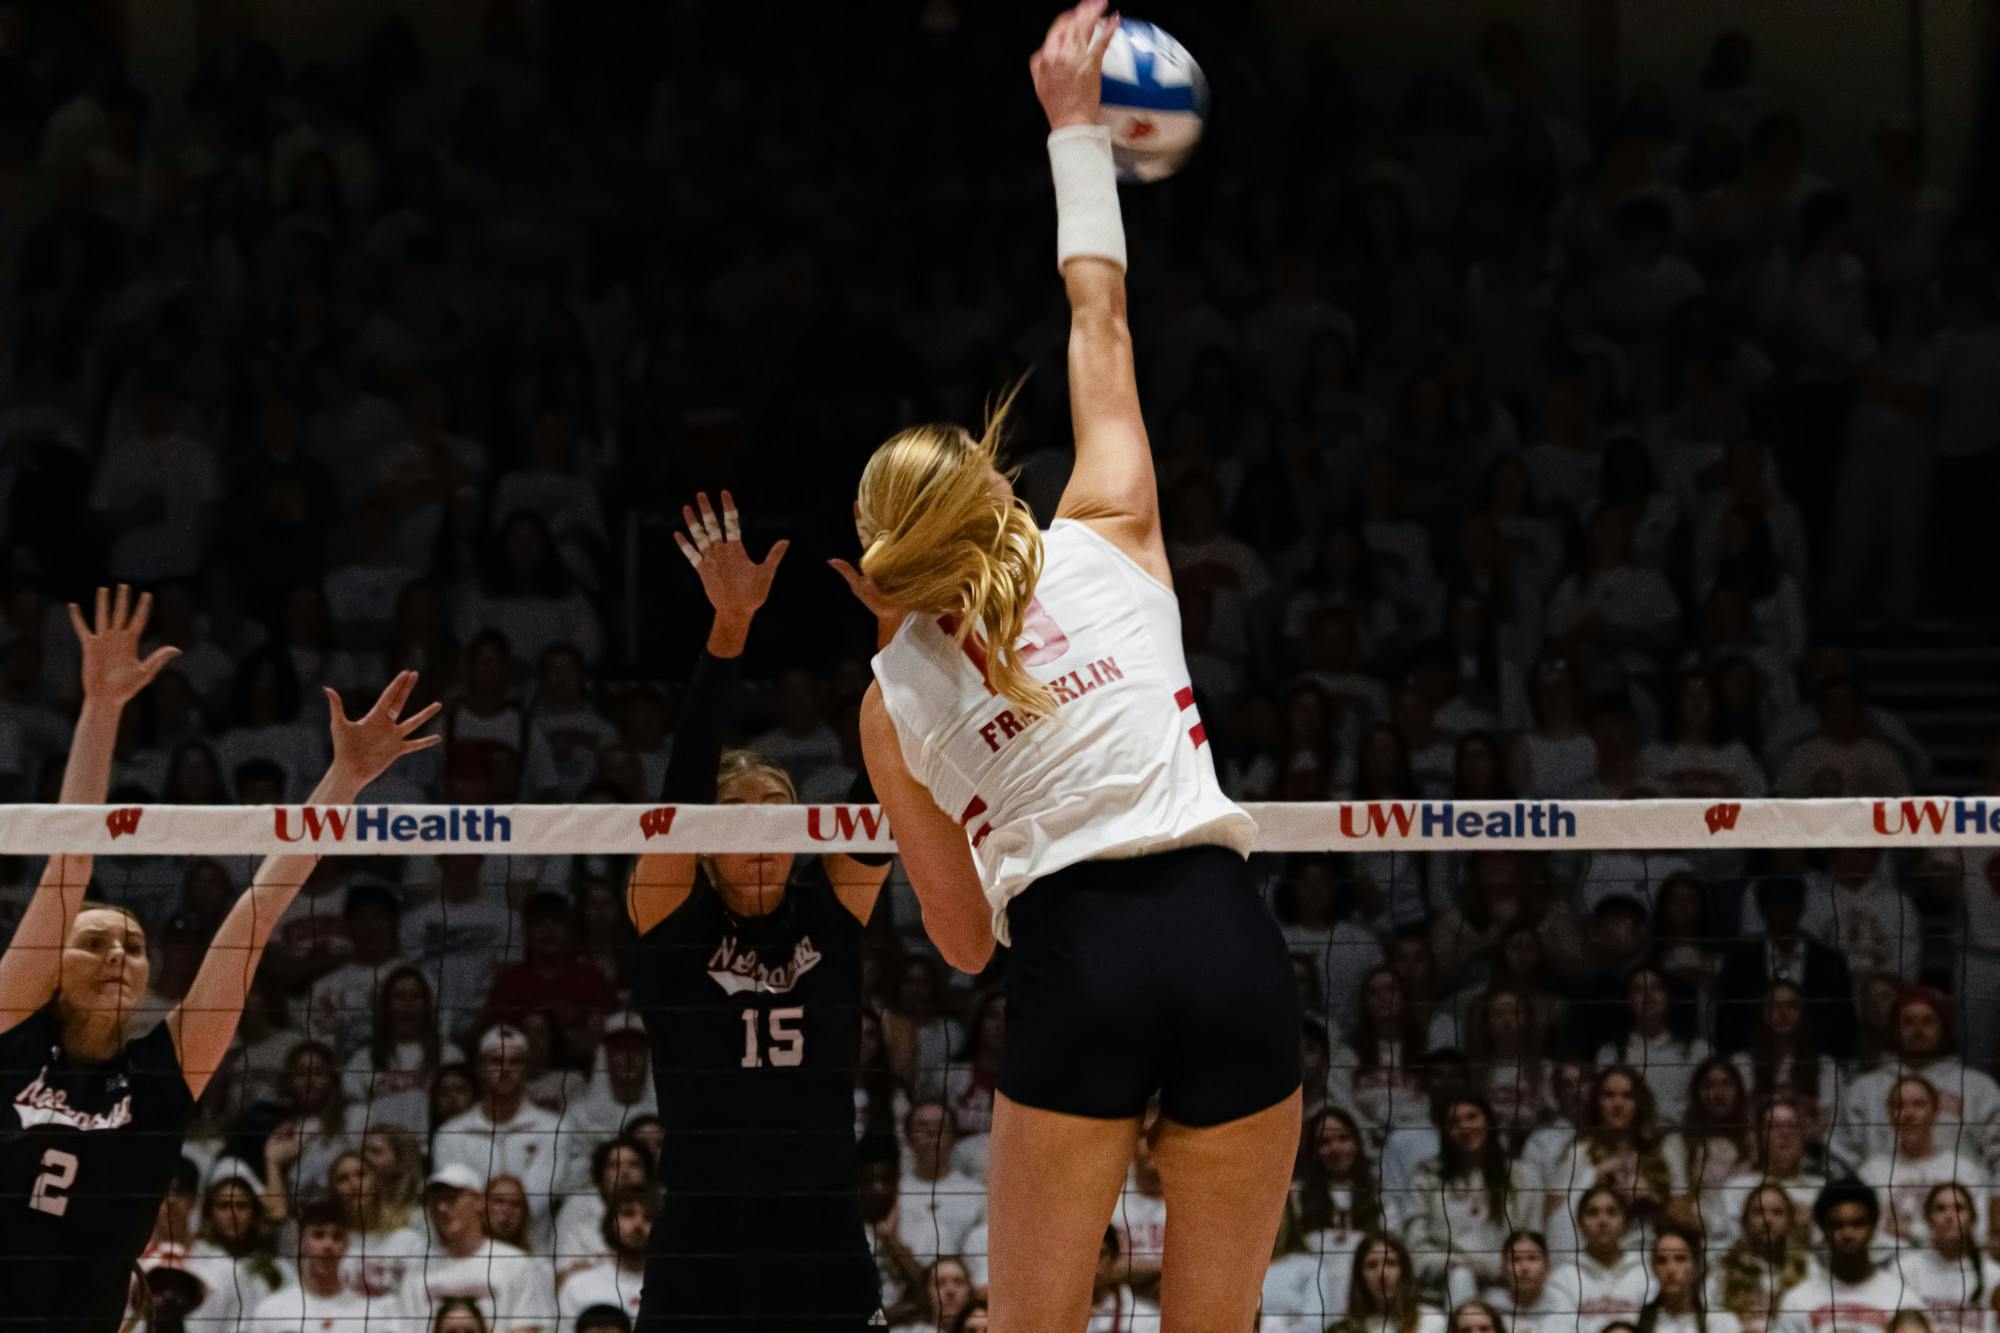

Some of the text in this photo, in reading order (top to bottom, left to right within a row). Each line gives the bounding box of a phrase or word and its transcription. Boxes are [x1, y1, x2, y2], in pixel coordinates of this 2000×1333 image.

[978, 656, 1124, 754] FRKLIN
[741, 1005, 804, 1068] 15
[29, 1149, 78, 1217] 2
